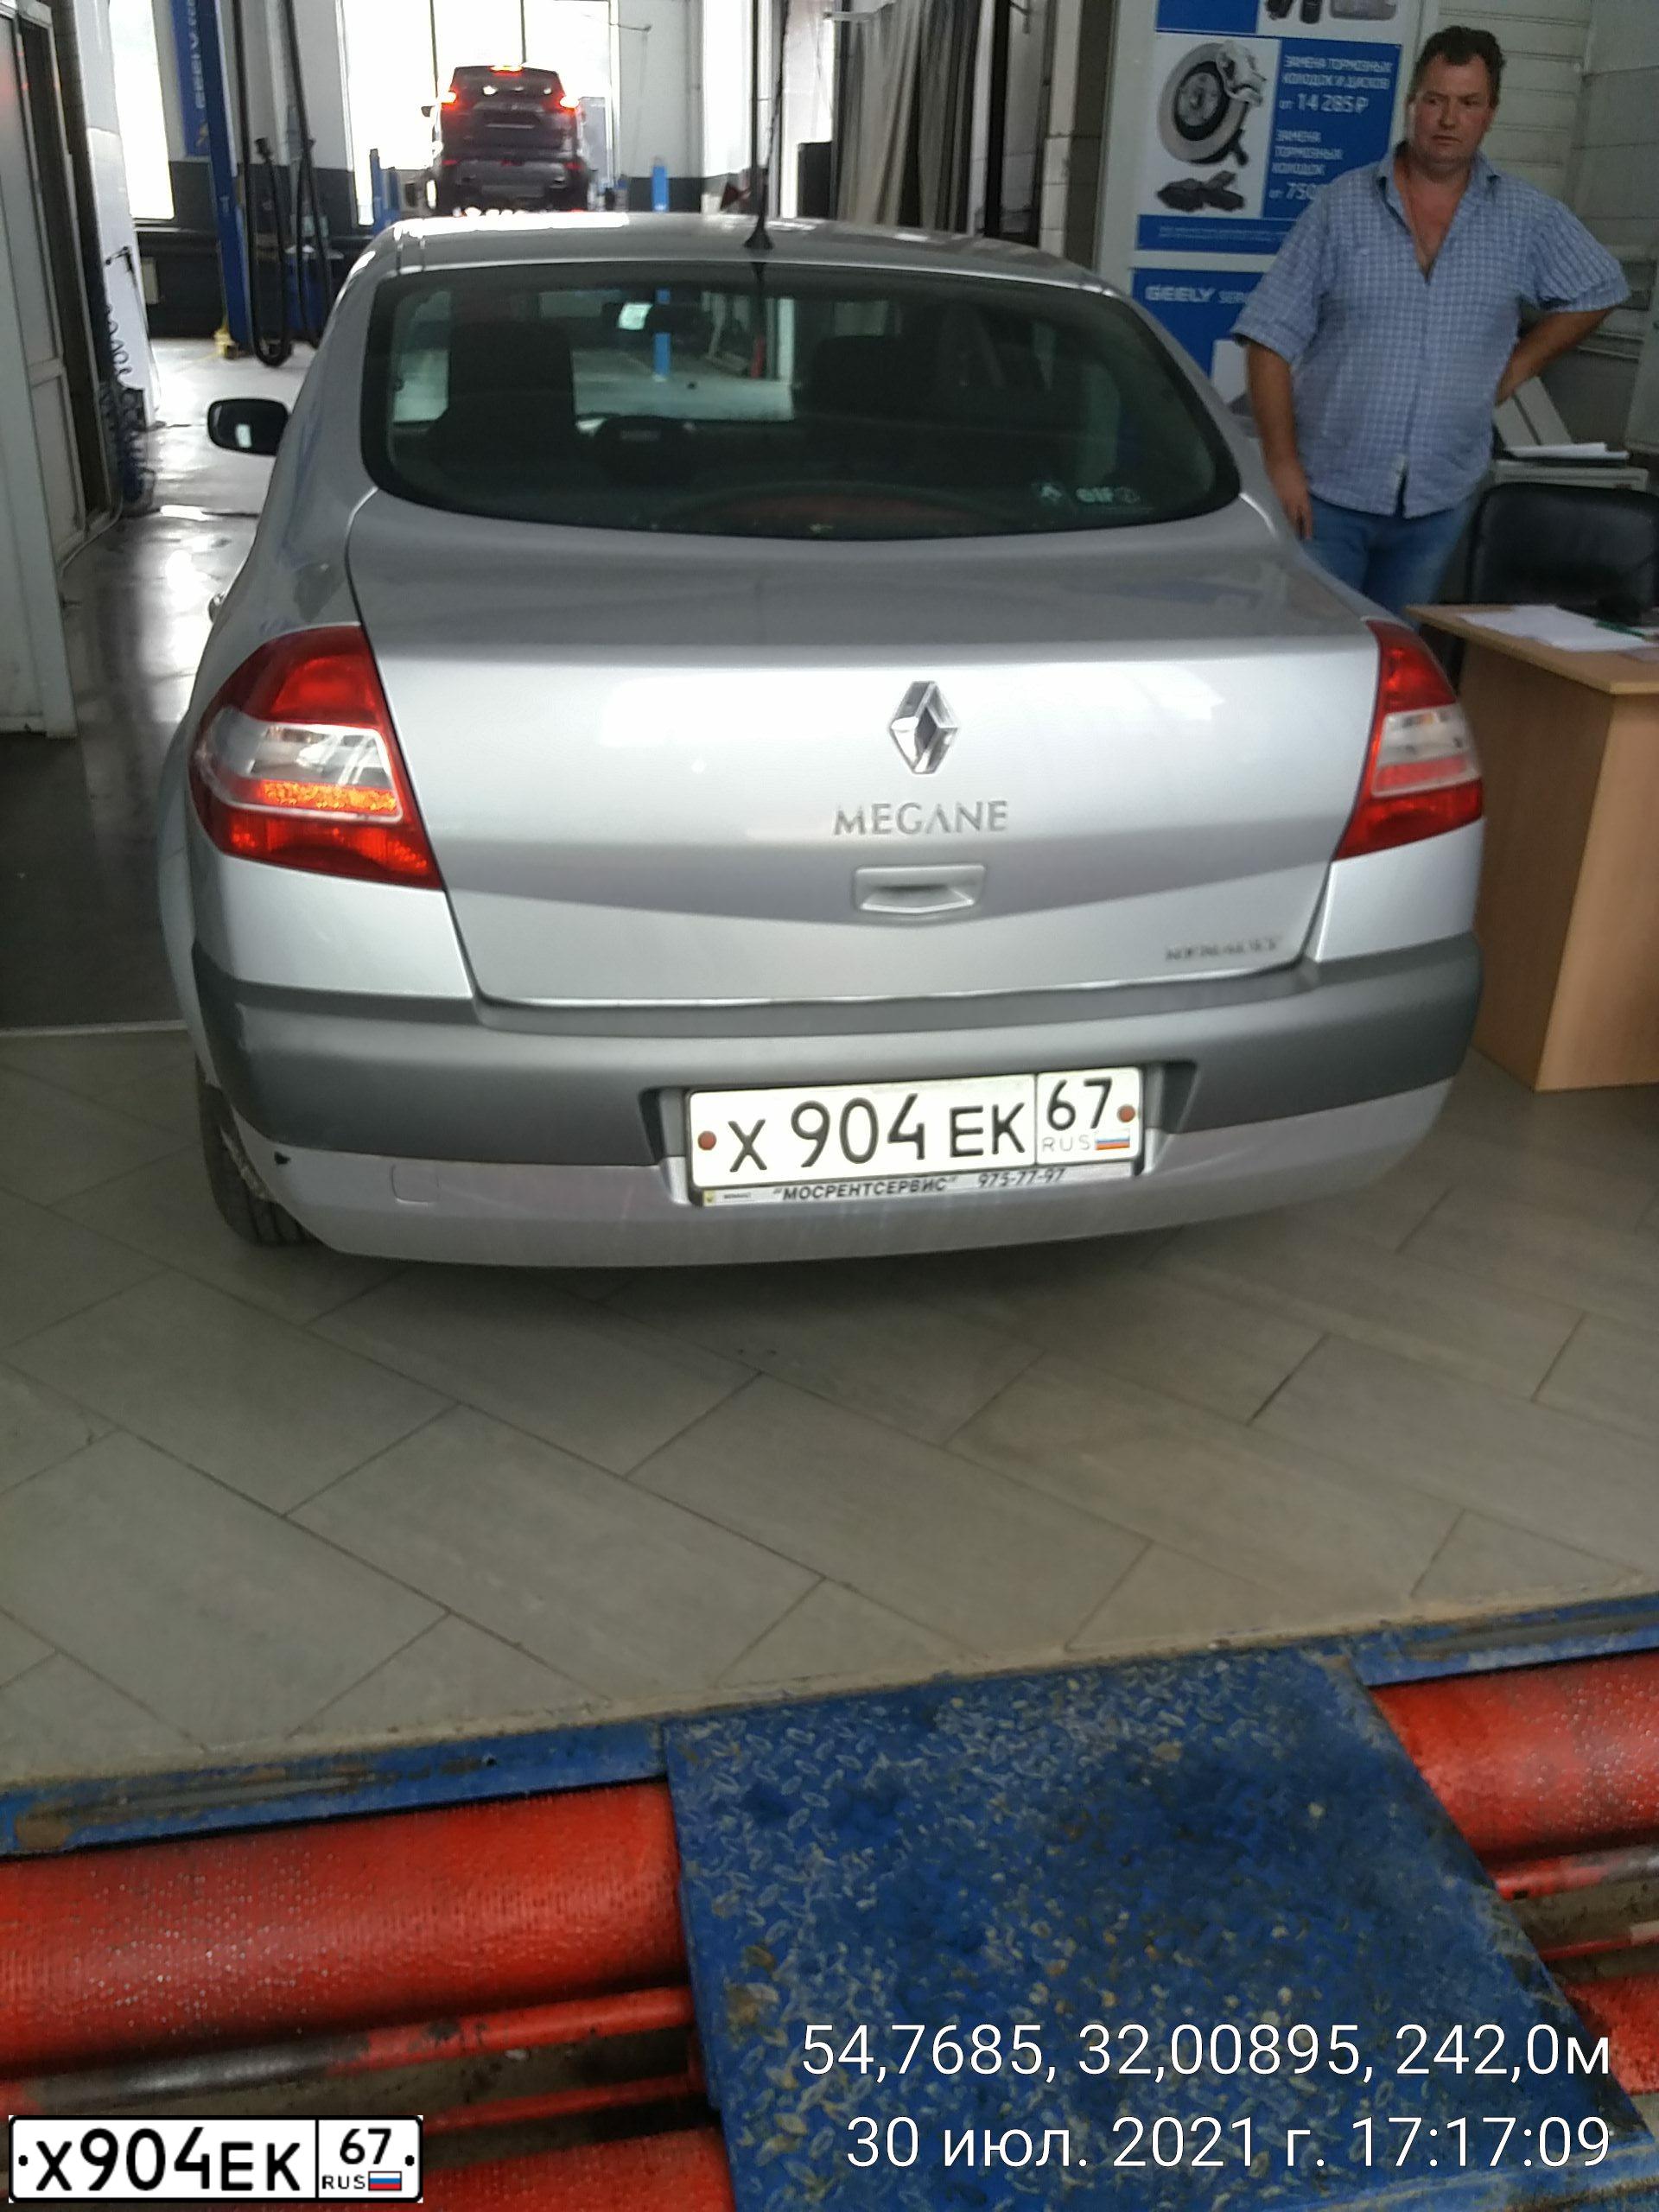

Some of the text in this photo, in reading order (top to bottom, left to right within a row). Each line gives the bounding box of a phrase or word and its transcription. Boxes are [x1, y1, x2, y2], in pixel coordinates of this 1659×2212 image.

[1145, 285, 1217, 302] GEELY
[832, 801, 1008, 836] MEGANE
[1046, 1077, 1113, 1130] 67
[1041, 1133, 1090, 1153] RUS
[977, 1168, 1065, 1188] 975-77-97
